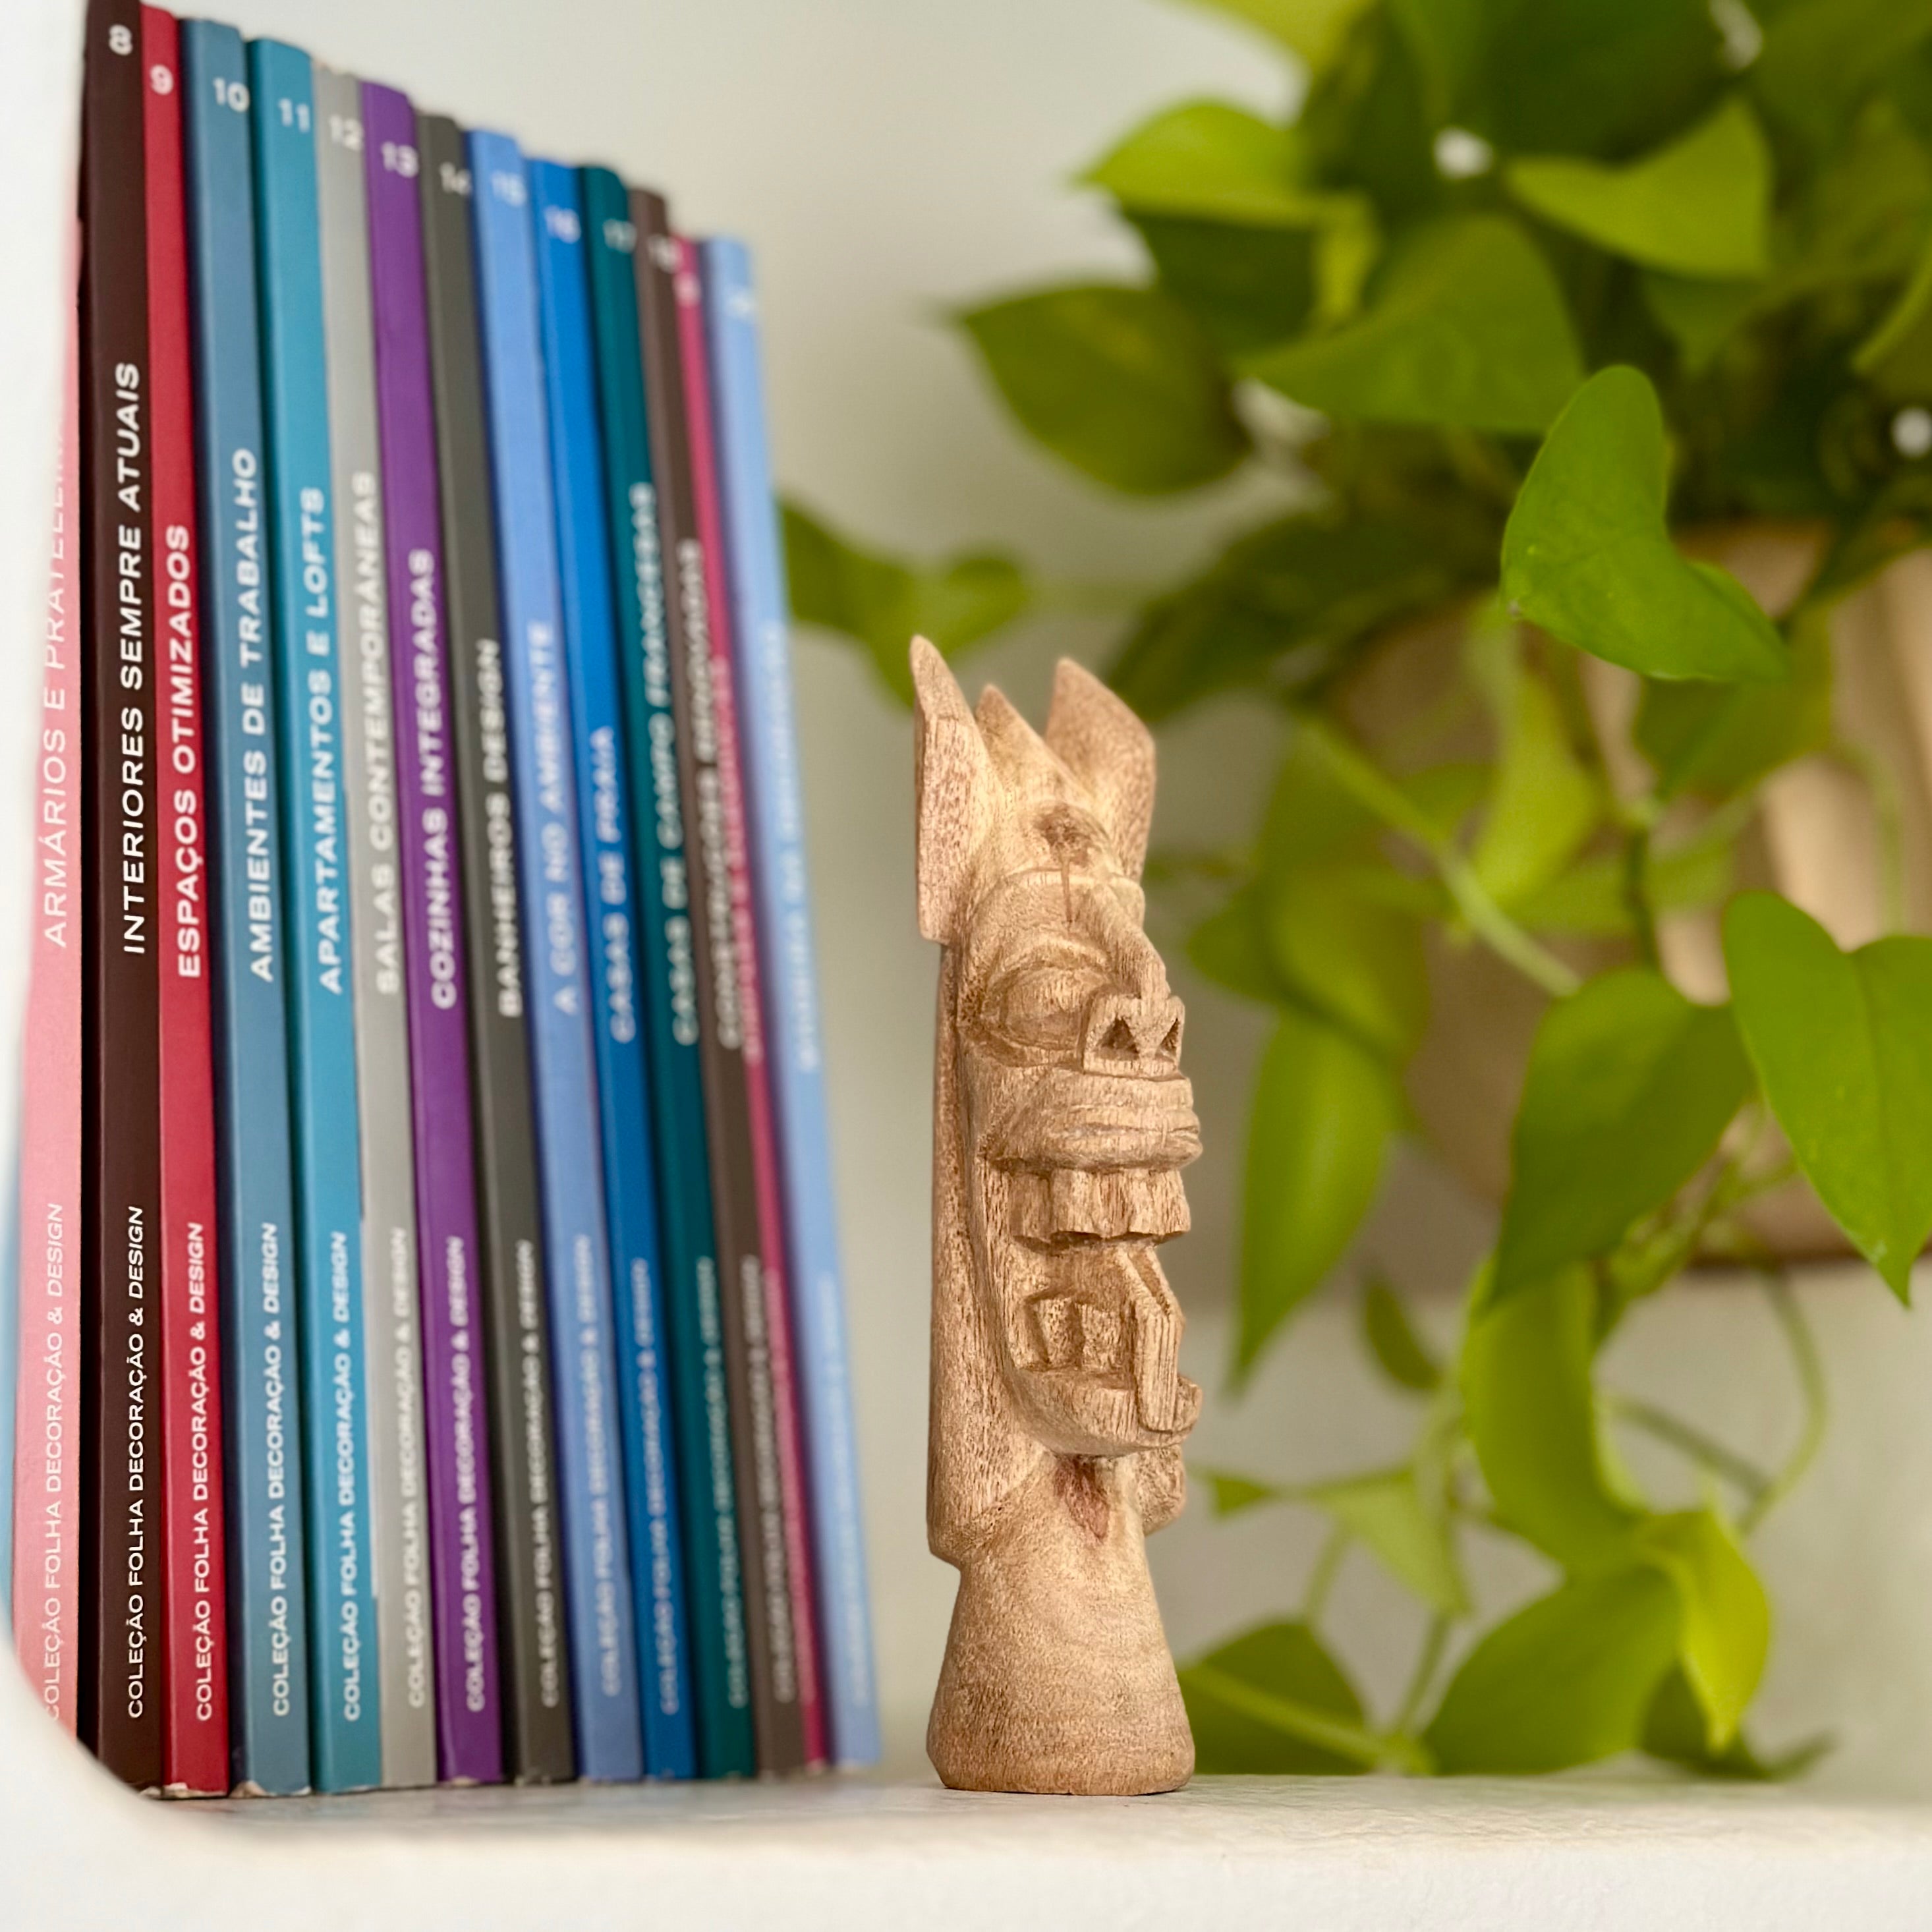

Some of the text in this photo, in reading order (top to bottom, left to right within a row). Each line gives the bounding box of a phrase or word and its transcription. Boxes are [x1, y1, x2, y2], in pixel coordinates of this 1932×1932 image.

[108, 24, 133, 56] 8
[150, 64, 174, 96] 9
[212, 76, 250, 113] 10
[277, 98, 311, 134] 11
[329, 114, 363, 152] 12
[380, 141, 420, 178] 13
[38, 727, 67, 948] ARMÁRIOS
[42, 686, 65, 711] E
[115, 363, 145, 953] INTERIORES SEMPRE ATUAIS
[165, 525, 202, 977] ESPAÇOS OTIMIZADOS
[232, 449, 273, 982] AMBIENTES DE TRABALHO
[300, 488, 342, 994] APARTAMENTOS E LOFTS
[351, 471, 399, 994] SALAS CONTEMPORÂNEAS
[407, 549, 457, 1009] COZINHAS INTEGRADAS
[476, 638, 523, 1017] BANHEIROS DESIGN
[43, 1332, 67, 1492] DECORAÇÃO
[46, 1203, 63, 1297] DESIGN
[47, 1307, 63, 1325] &
[45, 1500, 61, 1589] FOLHA
[126, 1206, 148, 1718] COLEÇÃO FOLHA DECORAÇÃO & DESIGN
[187, 1222, 214, 1721] COLEÇÃO FOLHA DECORAÇÃO & DESIGN
[262, 1222, 291, 1716] COLEÇÃO FOLHA DECORAÇÃO & DESIGN
[331, 1232, 360, 1721] COLEÇÃO FOLHA DECORAÇÃO & DESIGN
[390, 1226, 425, 1707] COLEÇÃO FOLHA DECORAÇÃO & DESIGN
[446, 1236, 485, 1712] COLEÇÃO FOLHA DECORAÇÃO & DESIGN
